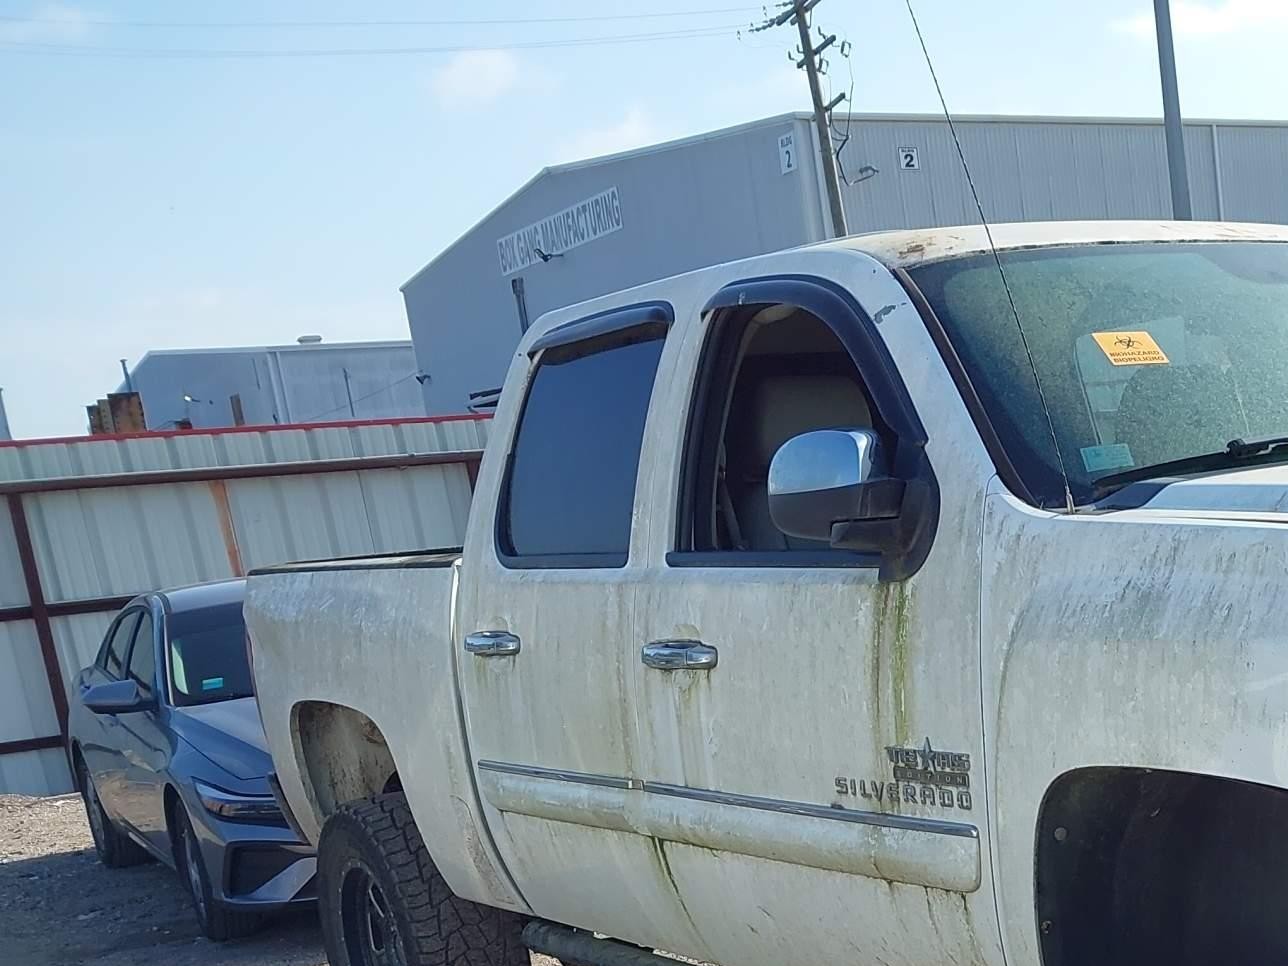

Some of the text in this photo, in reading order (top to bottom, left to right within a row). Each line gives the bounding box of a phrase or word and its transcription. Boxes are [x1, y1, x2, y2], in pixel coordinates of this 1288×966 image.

[785, 150, 792, 168] 2
[904, 154, 915, 168] 2
[540, 190, 621, 253] MANUFACTURING
[884, 737, 970, 772] TEXAS
[835, 776, 972, 811] SILVERADO
